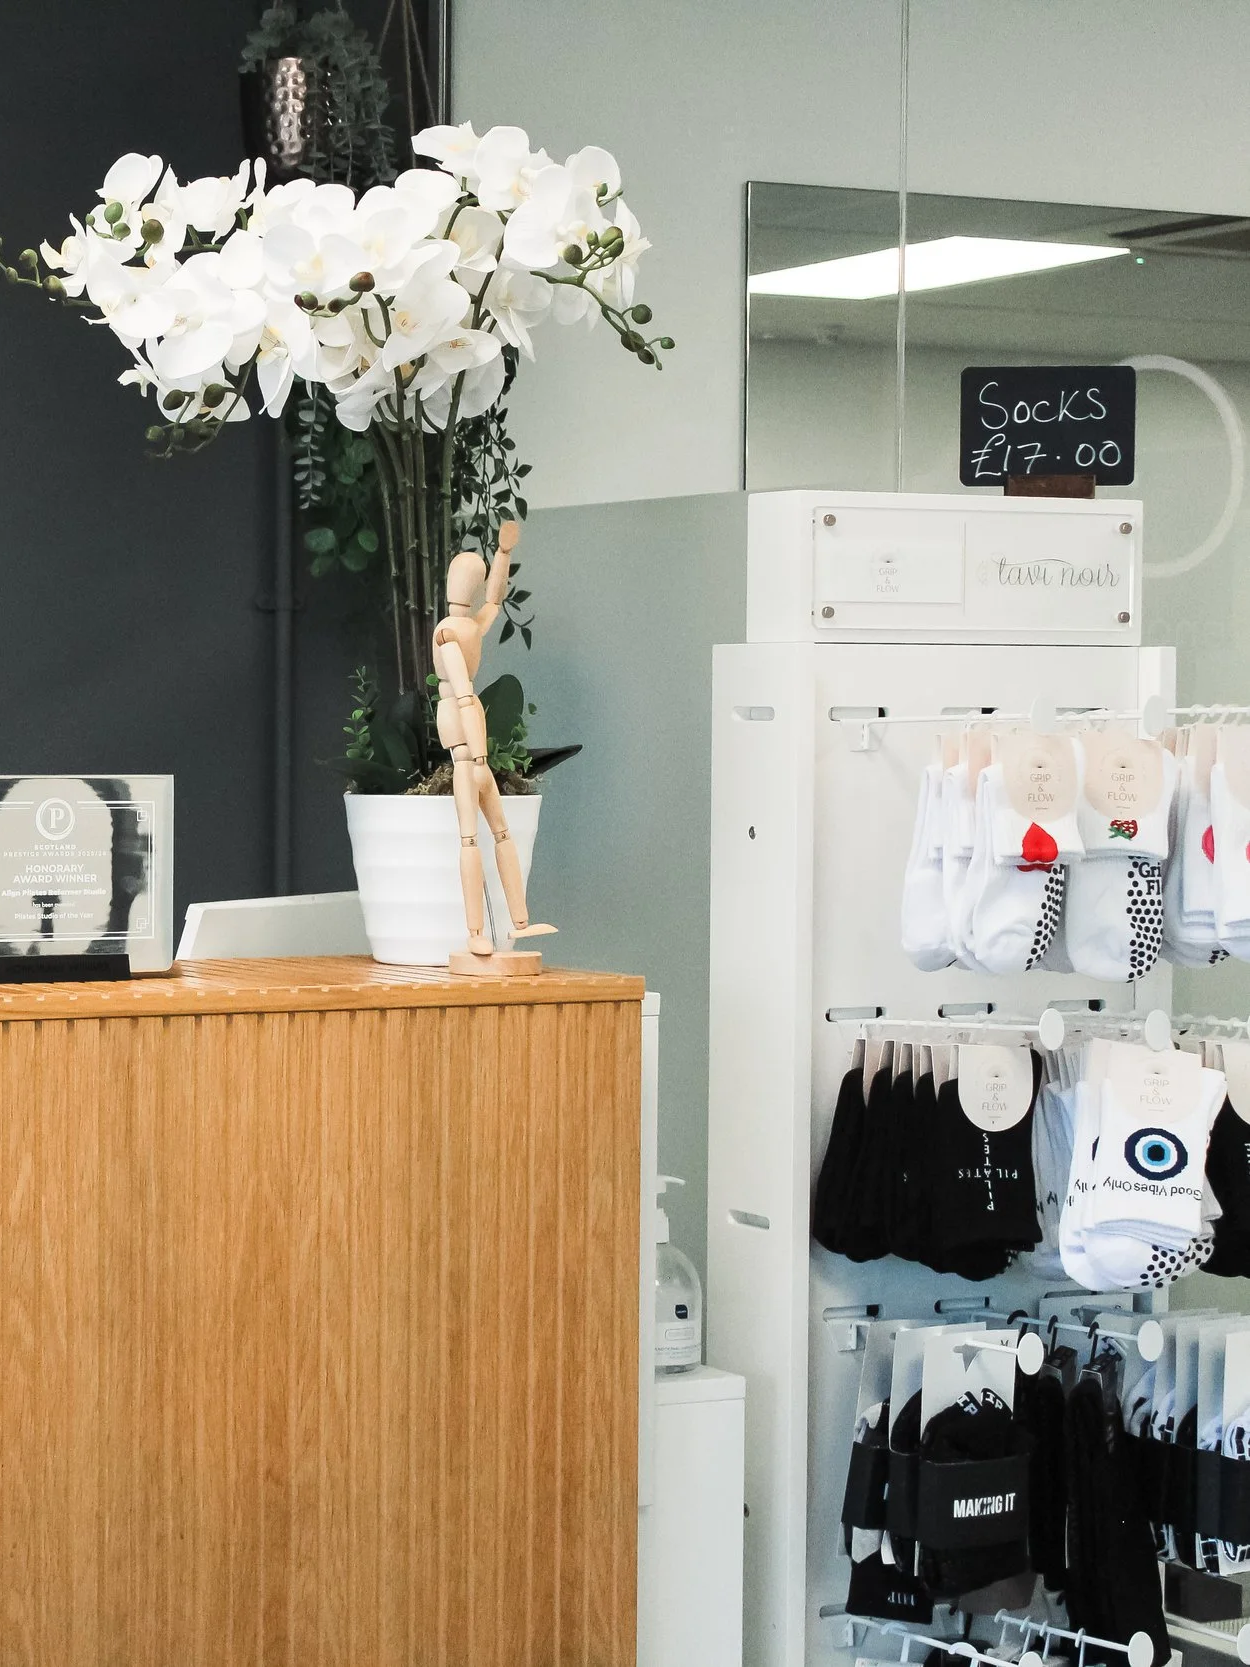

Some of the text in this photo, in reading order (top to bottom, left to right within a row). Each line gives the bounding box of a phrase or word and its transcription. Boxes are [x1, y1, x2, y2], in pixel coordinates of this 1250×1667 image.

[970, 433, 1122, 478] £17.00
[878, 567, 898, 576] GRIP
[997, 557, 1121, 587] tavi noir
[876, 584, 900, 593] FLOW
[1030, 773, 1052, 783] GRIP
[1111, 773, 1135, 783] GRIP
[1038, 784, 1044, 792] &
[1119, 783, 1126, 792] &
[1027, 792, 1054, 803] FLOW
[1107, 791, 1138, 802] FLOW
[25, 864, 84, 873] HONORARY
[1138, 861, 1162, 878] Gri
[13, 874, 97, 884] AWARD WINNER
[1, 889, 21, 897] Align
[1143, 1077, 1170, 1087] GRIP
[985, 1083, 1007, 1092] GRIP
[1152, 1087, 1160, 1096] &
[992, 1092, 999, 1101] &
[1139, 1095, 1173, 1105] FLOW
[981, 1102, 1008, 1111] FLOW
[1170, 1186, 1203, 1201] Good
[954, 1493, 1016, 1518] MAKING IT
